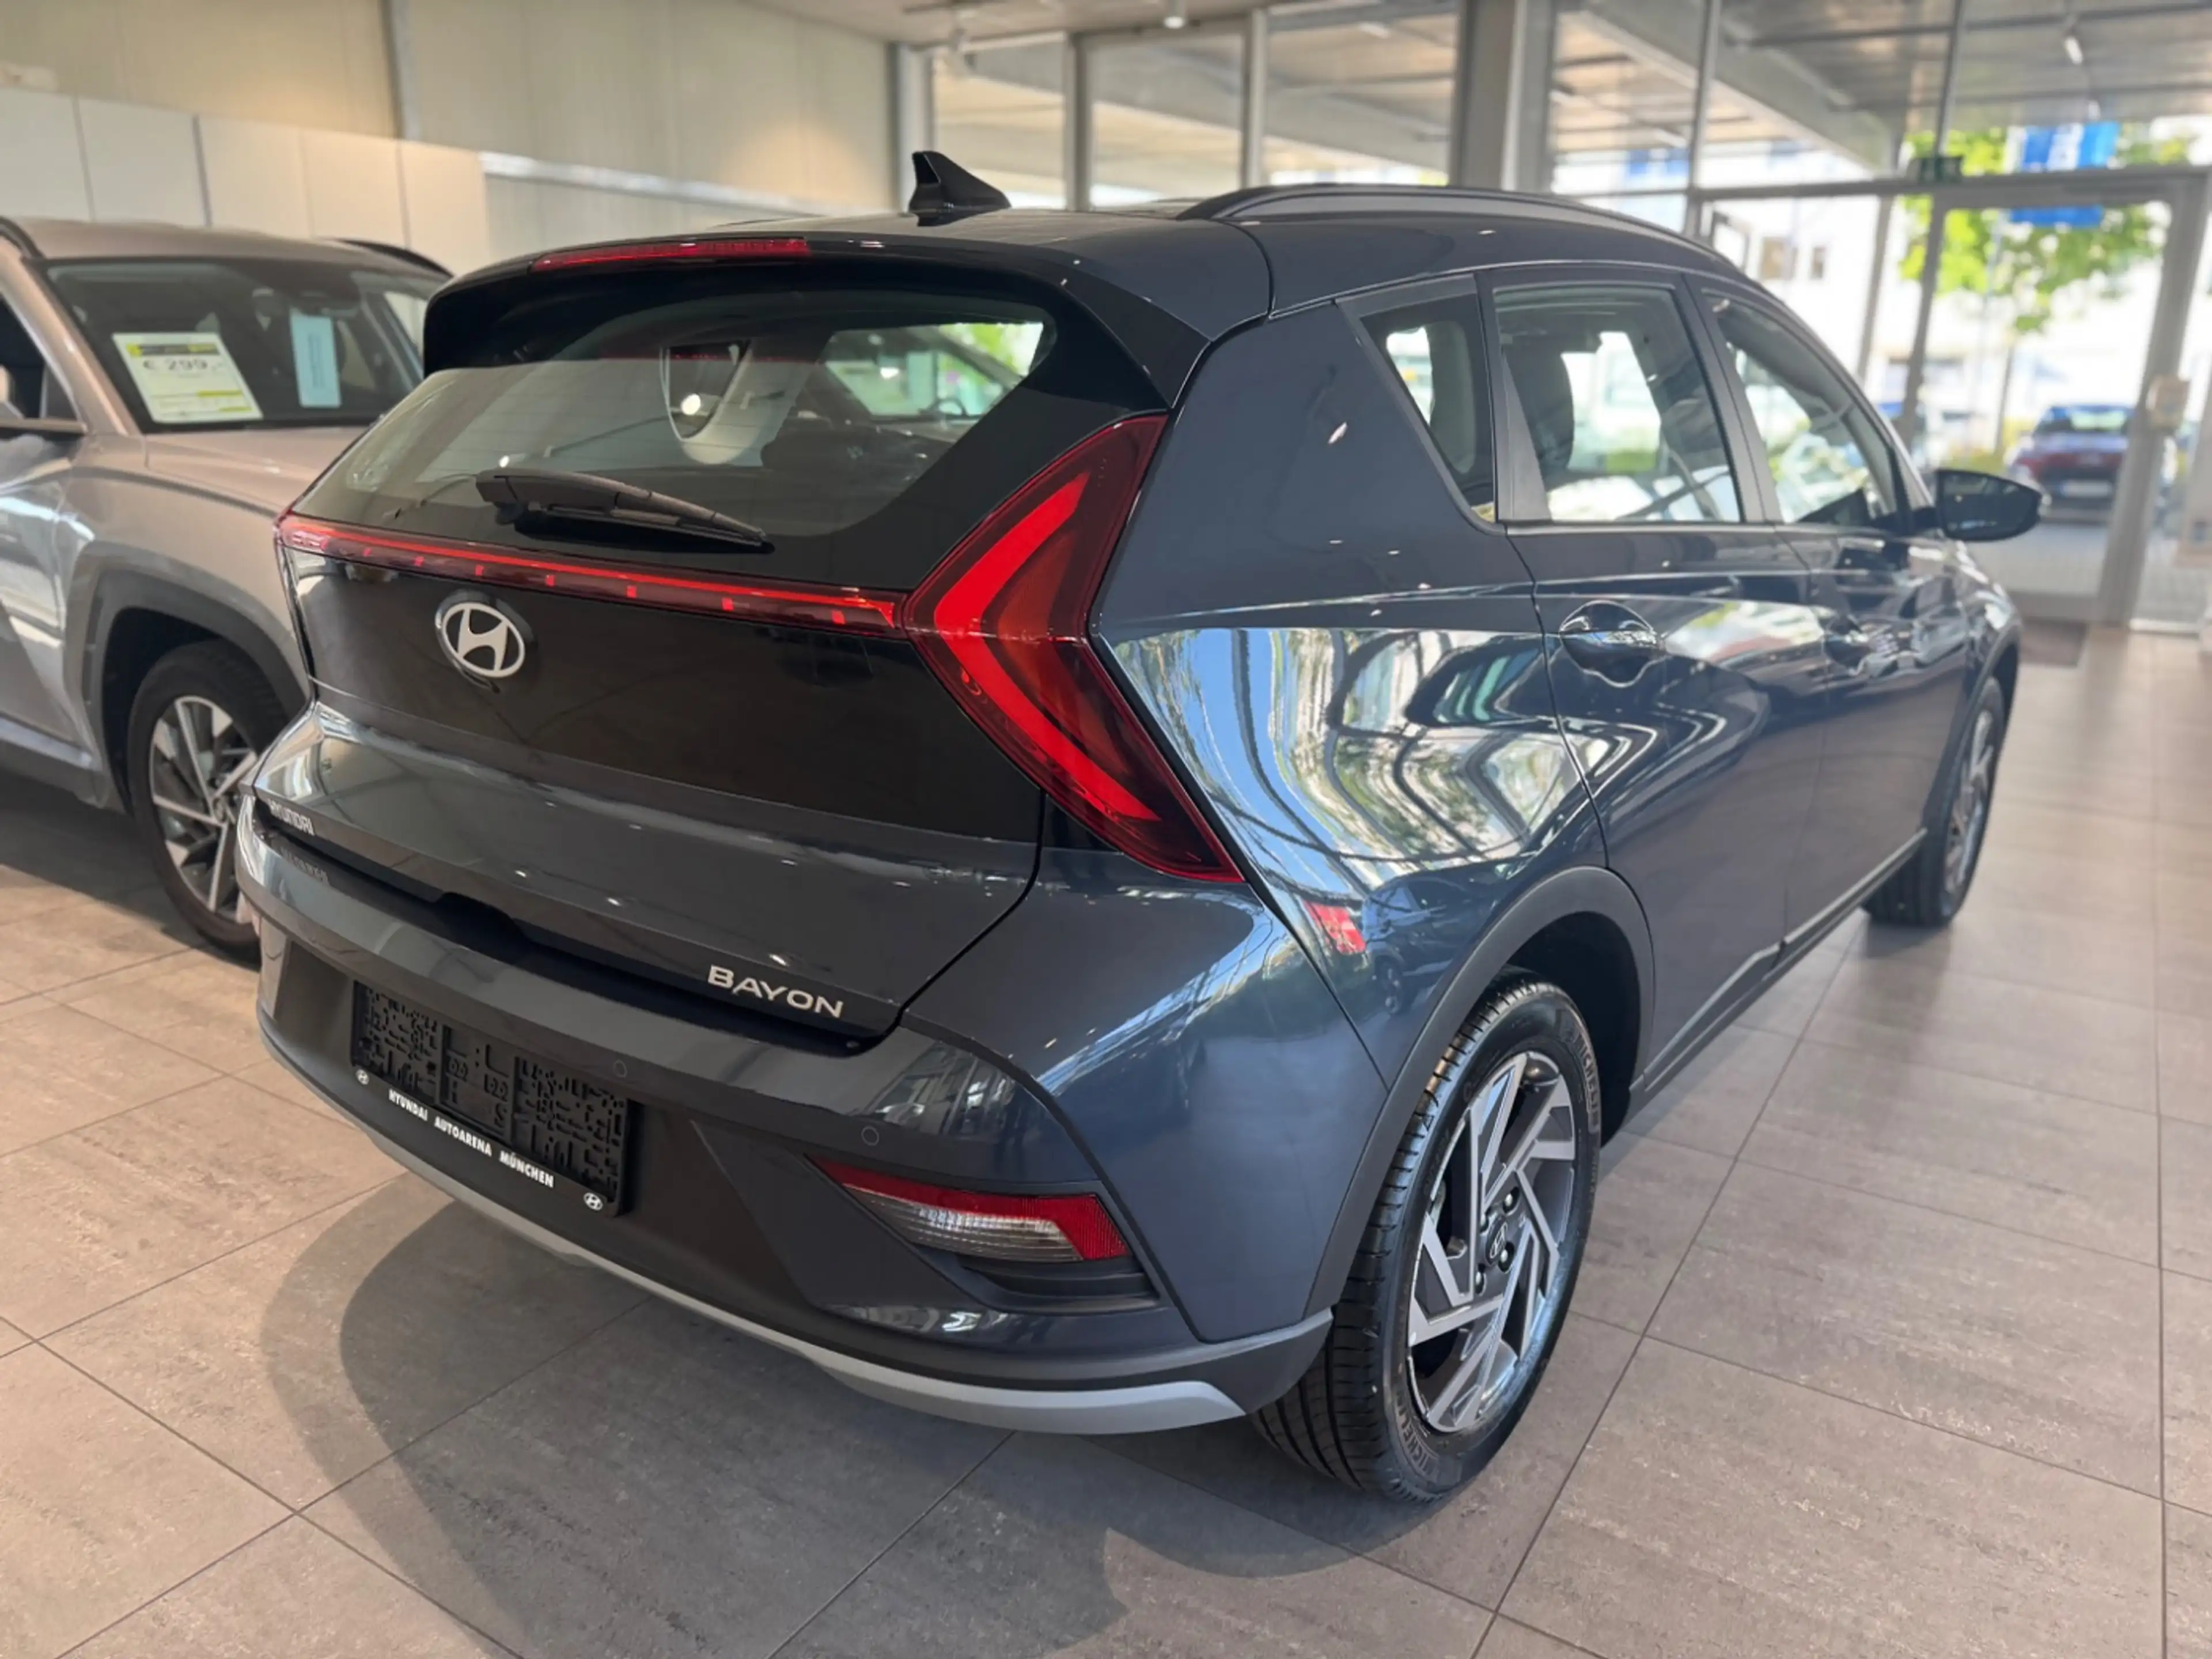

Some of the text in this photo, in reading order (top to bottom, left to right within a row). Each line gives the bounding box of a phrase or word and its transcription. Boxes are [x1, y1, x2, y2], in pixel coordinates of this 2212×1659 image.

[707, 964, 844, 1018] BAYON
[388, 1088, 554, 1188] HYUNDAI AUTOARENA MÜNCHEN
